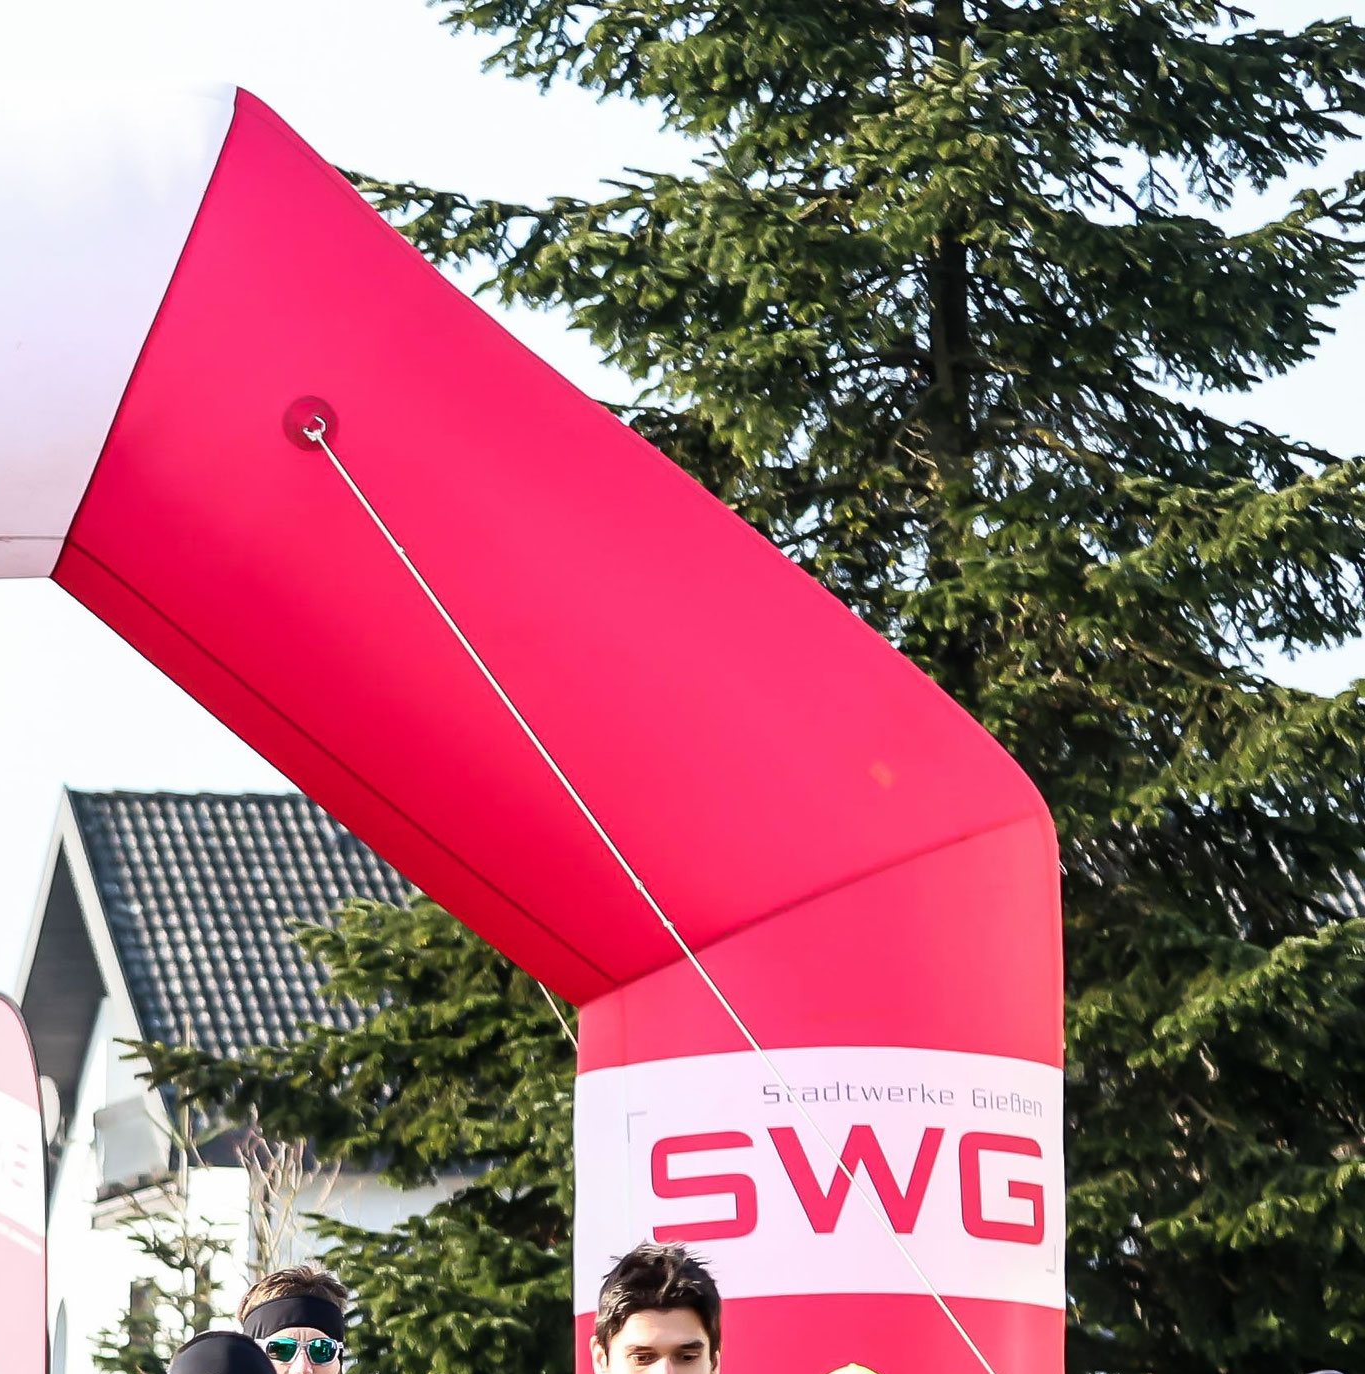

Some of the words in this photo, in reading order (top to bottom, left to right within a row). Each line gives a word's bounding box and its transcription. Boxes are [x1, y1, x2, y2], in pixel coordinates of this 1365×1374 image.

[763, 1081, 955, 1107] Stadtwerke
[971, 1087, 1043, 1119] Gießen
[651, 1124, 1045, 1245] SWG
